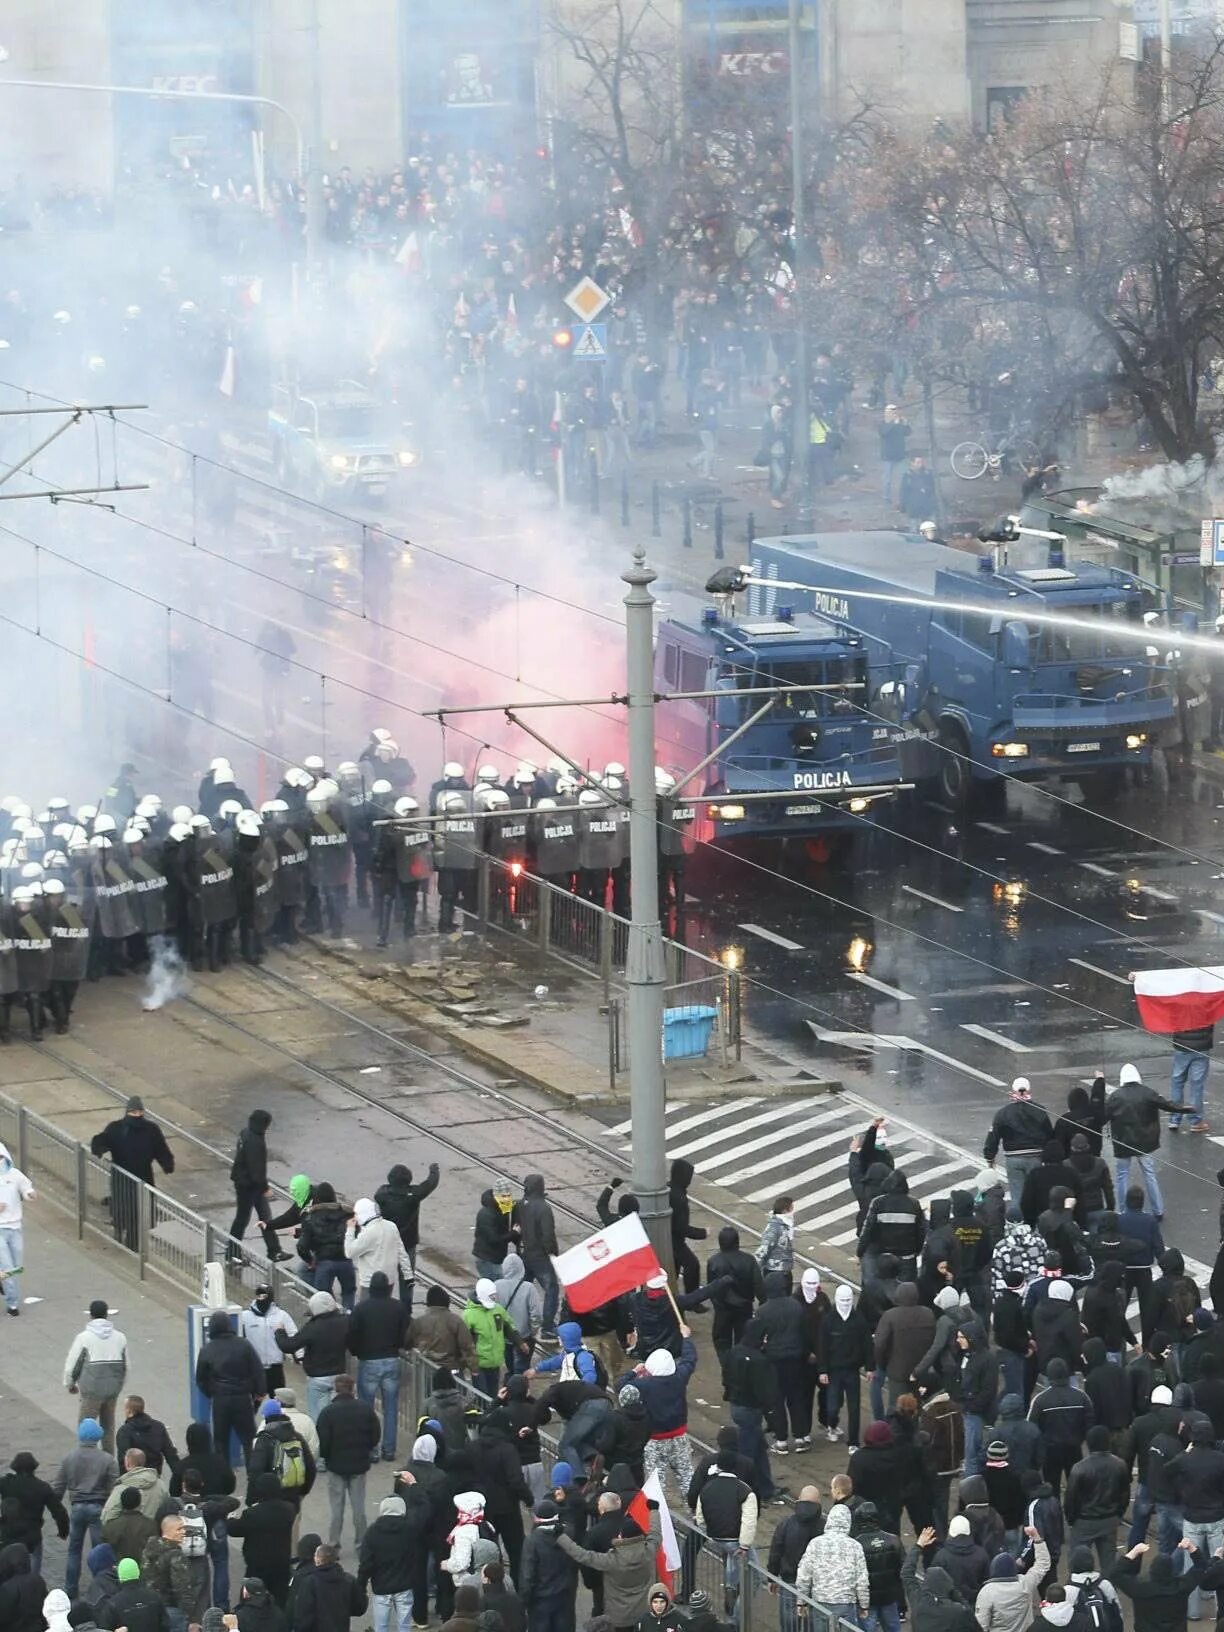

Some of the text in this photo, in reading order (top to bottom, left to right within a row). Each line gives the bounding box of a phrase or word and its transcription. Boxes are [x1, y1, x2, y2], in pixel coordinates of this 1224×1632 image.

[815, 592, 849, 620] POLICJA
[794, 771, 851, 788] POLICJA
[673, 808, 696, 820] POLICJA
[446, 821, 475, 833] POLICJA
[544, 825, 574, 839] POLICJA
[590, 821, 617, 833] POLICJA
[311, 833, 347, 846] POLICJA
[202, 867, 234, 885] POLICJA
[52, 926, 89, 938] POLICJA
[14, 938, 52, 950] POLICJA
